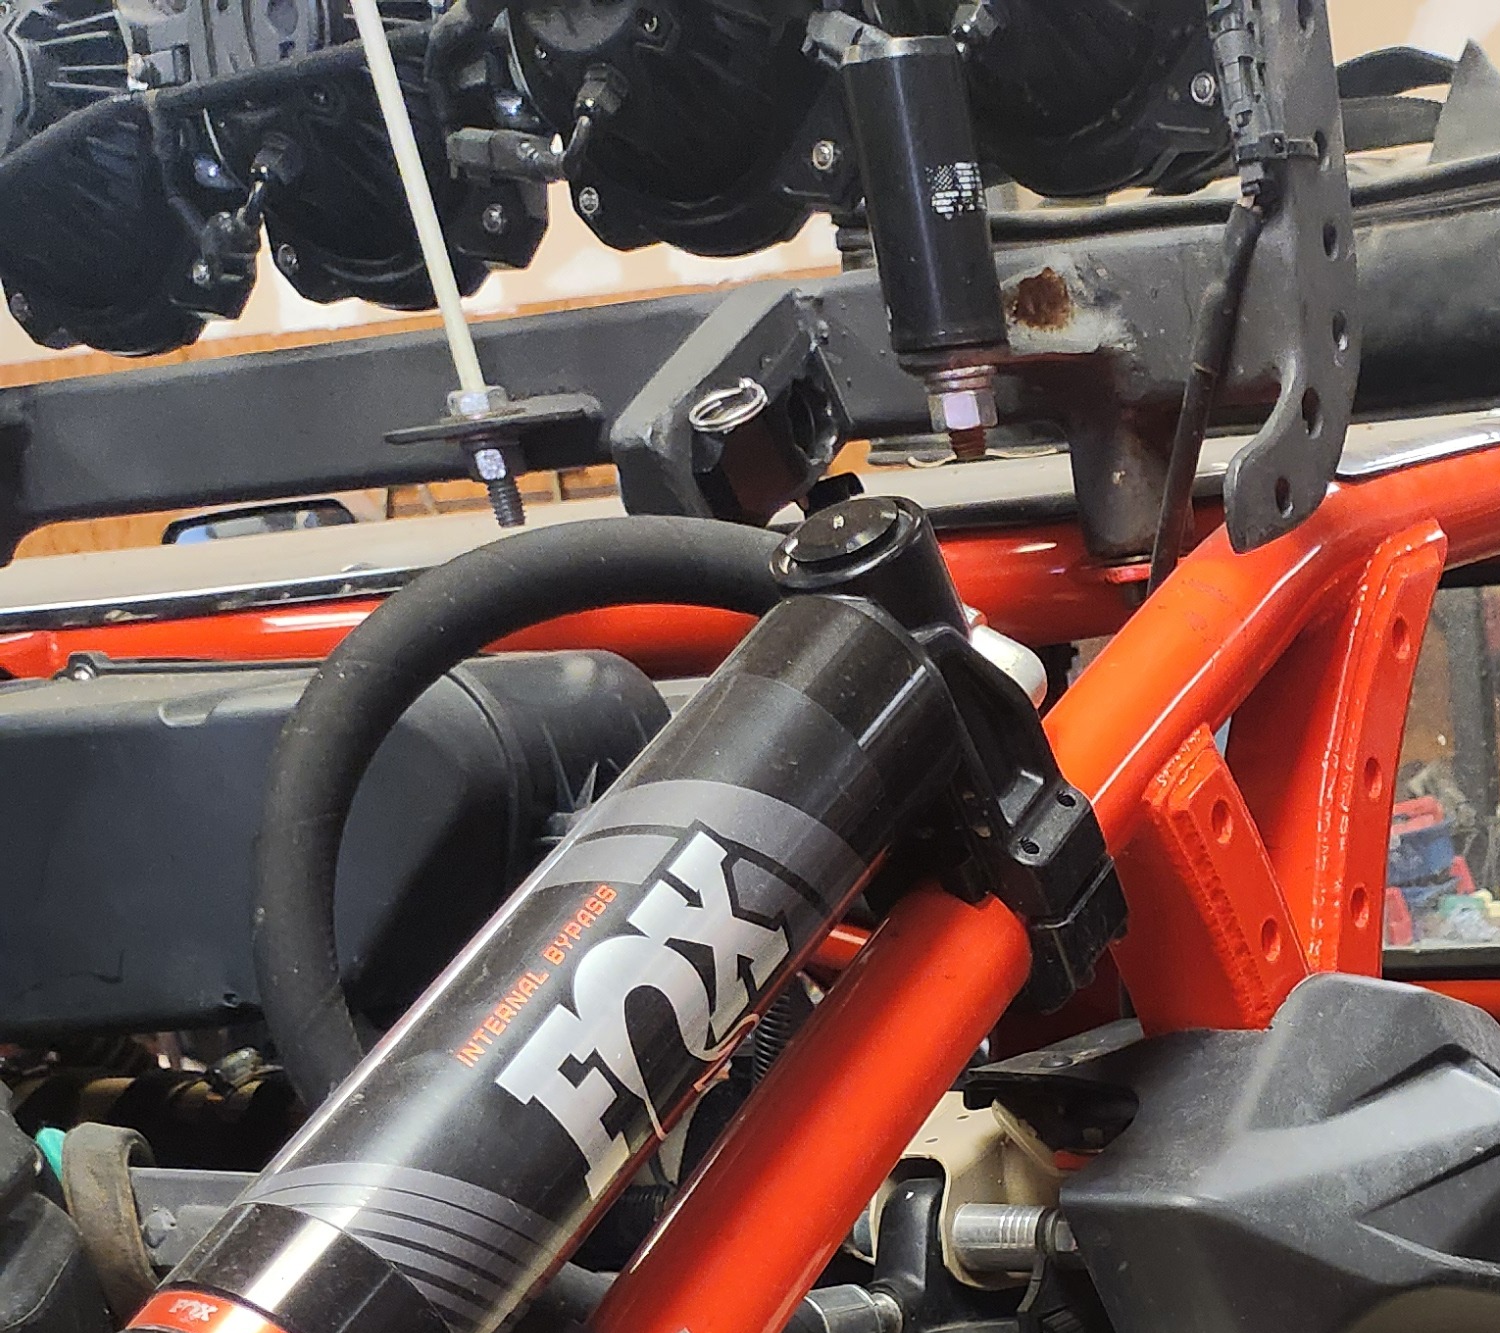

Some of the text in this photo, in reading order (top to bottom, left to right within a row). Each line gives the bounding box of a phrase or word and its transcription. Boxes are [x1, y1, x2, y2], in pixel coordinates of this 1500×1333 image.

[456, 883, 619, 1069] INTERNAL BYPASS
[495, 831, 791, 1201] FOX
[168, 1298, 219, 1322] FOX
